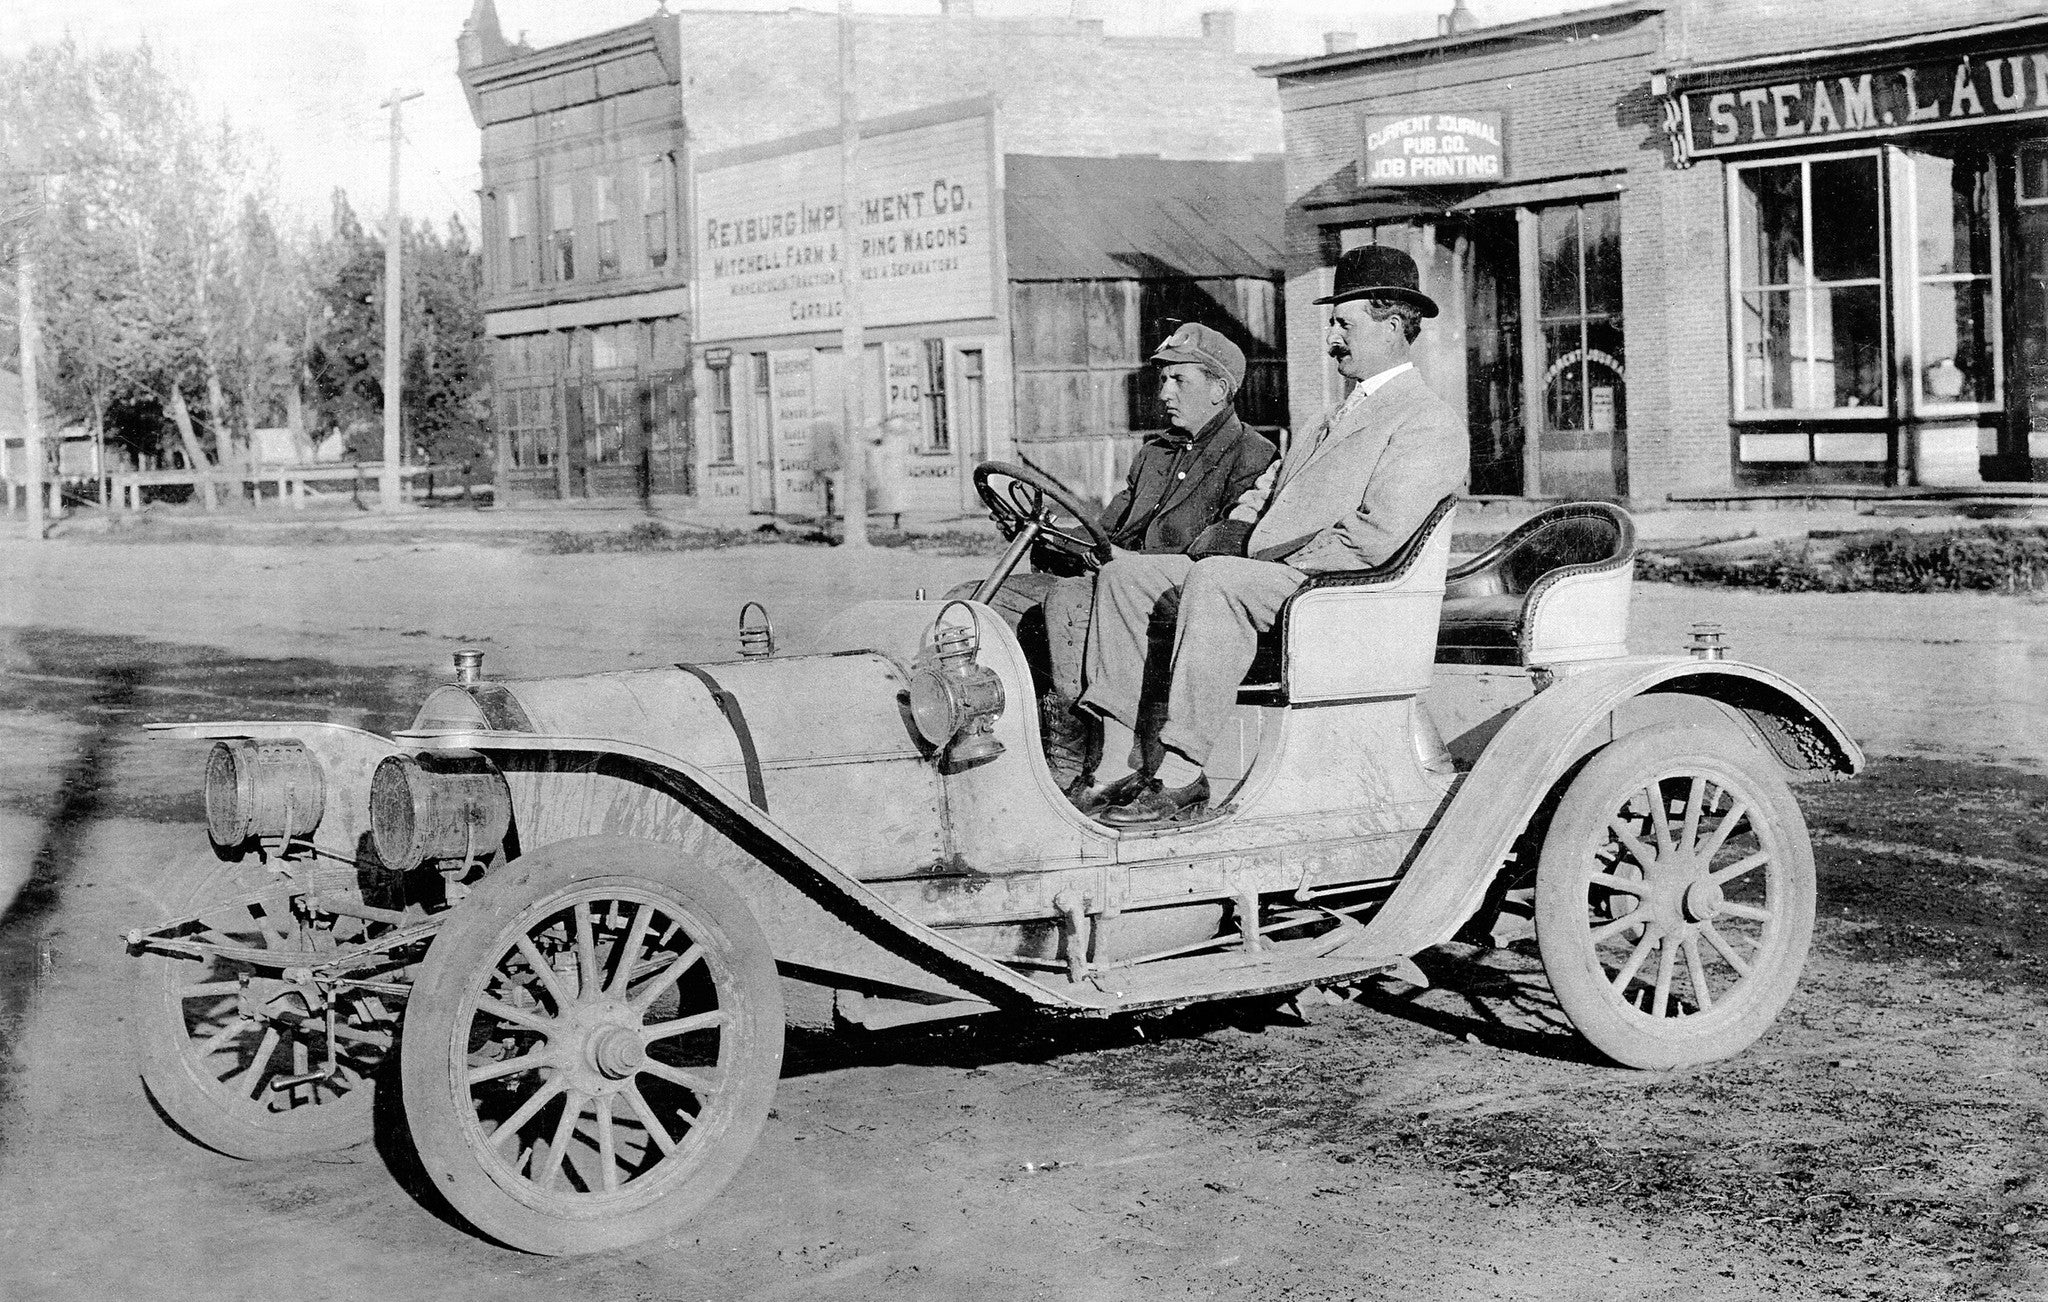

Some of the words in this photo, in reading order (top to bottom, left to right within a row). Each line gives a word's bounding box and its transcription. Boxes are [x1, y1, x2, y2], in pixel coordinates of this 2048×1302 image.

[1367, 115, 1433, 151] CURRENT
[1436, 115, 1501, 147] JOURNAL
[1371, 157, 1406, 179] JOB
[1410, 154, 1498, 178] PRINTING
[707, 210, 796, 249] REXBURG
[932, 178, 972, 216] CO.
[714, 252, 781, 279] MITCHELL
[786, 245, 824, 269] FARM
[903, 225, 968, 253] WAGONS
